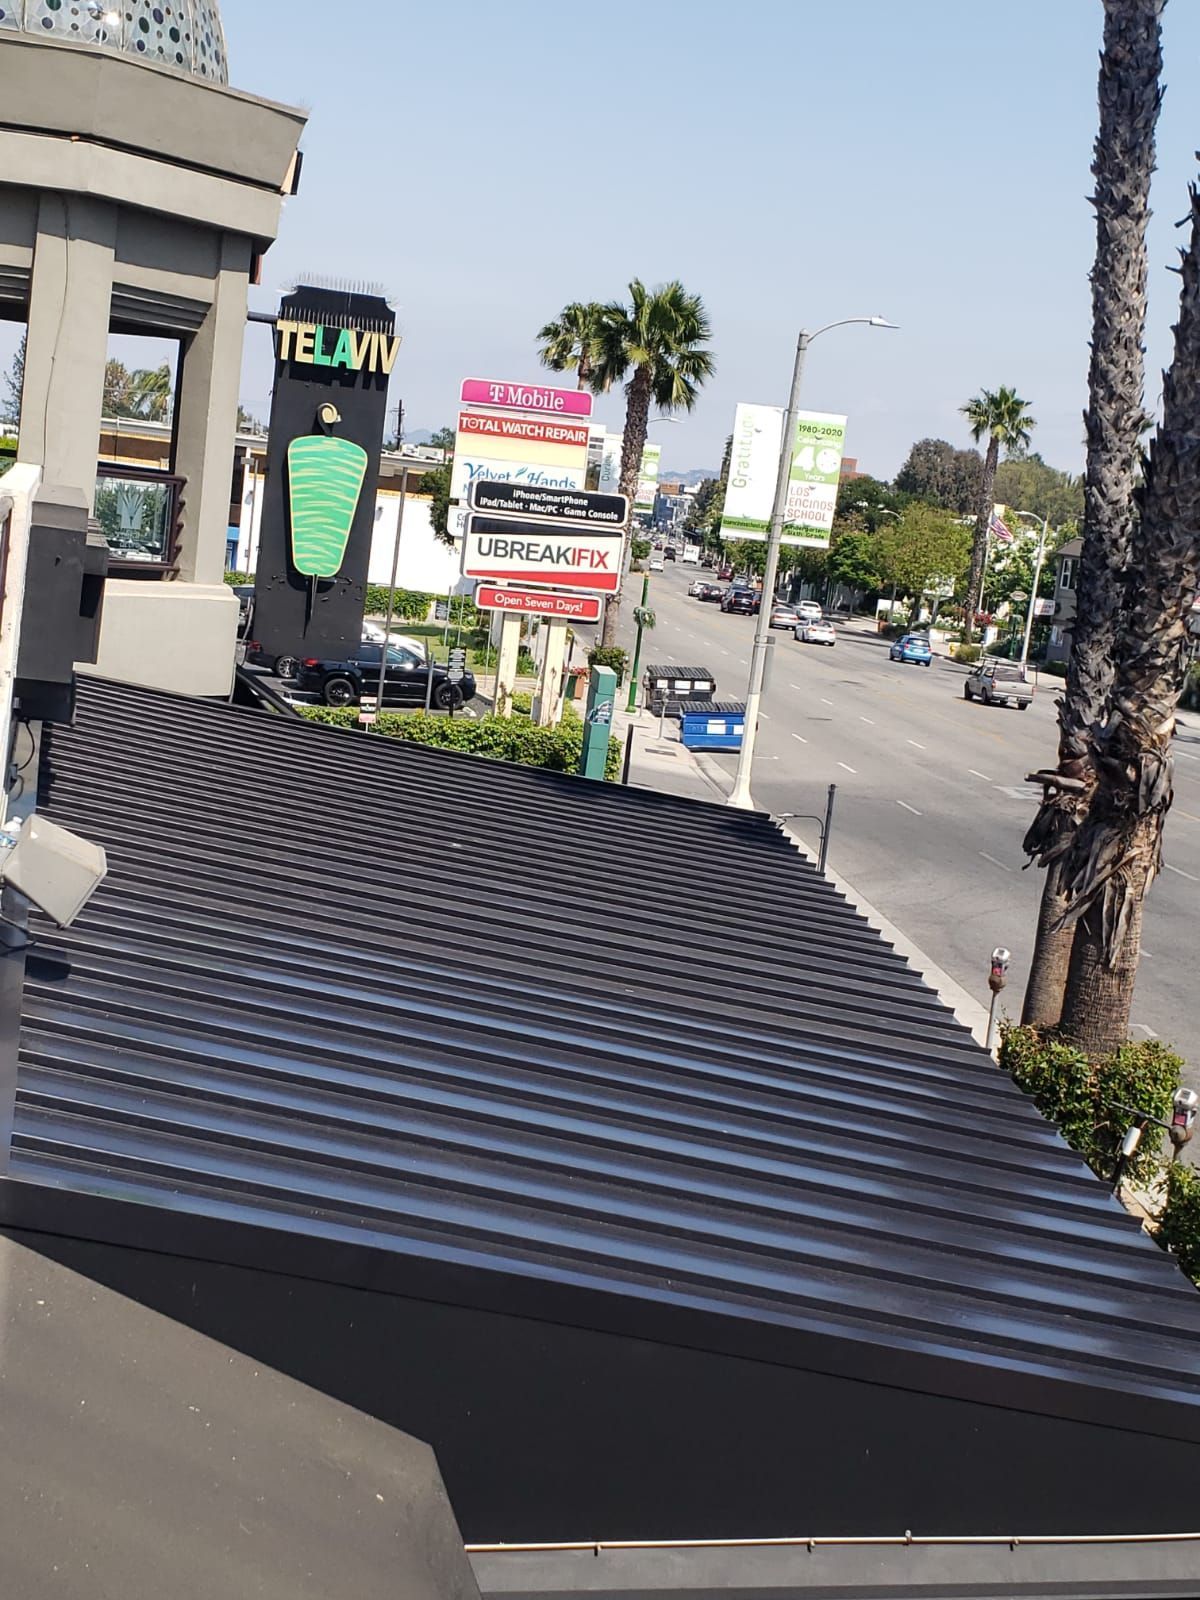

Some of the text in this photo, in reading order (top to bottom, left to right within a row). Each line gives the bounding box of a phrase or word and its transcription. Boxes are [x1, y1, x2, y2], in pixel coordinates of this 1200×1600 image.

[506, 386, 565, 411] Mobile
[460, 416, 587, 444] TOTAL WATCH REPAIR
[798, 424, 843, 438] 1980-2020
[463, 463, 577, 489] Velvet Hands
[512, 488, 589, 506] iPhone/SmartPhone
[790, 486, 811, 497] LOS
[480, 496, 619, 521] iPad/Tablet Mac/PC Game Console
[786, 508, 829, 523] SCHOOL
[478, 537, 609, 570] UBREAKIFIX
[494, 593, 583, 613] Open Seven Days!
